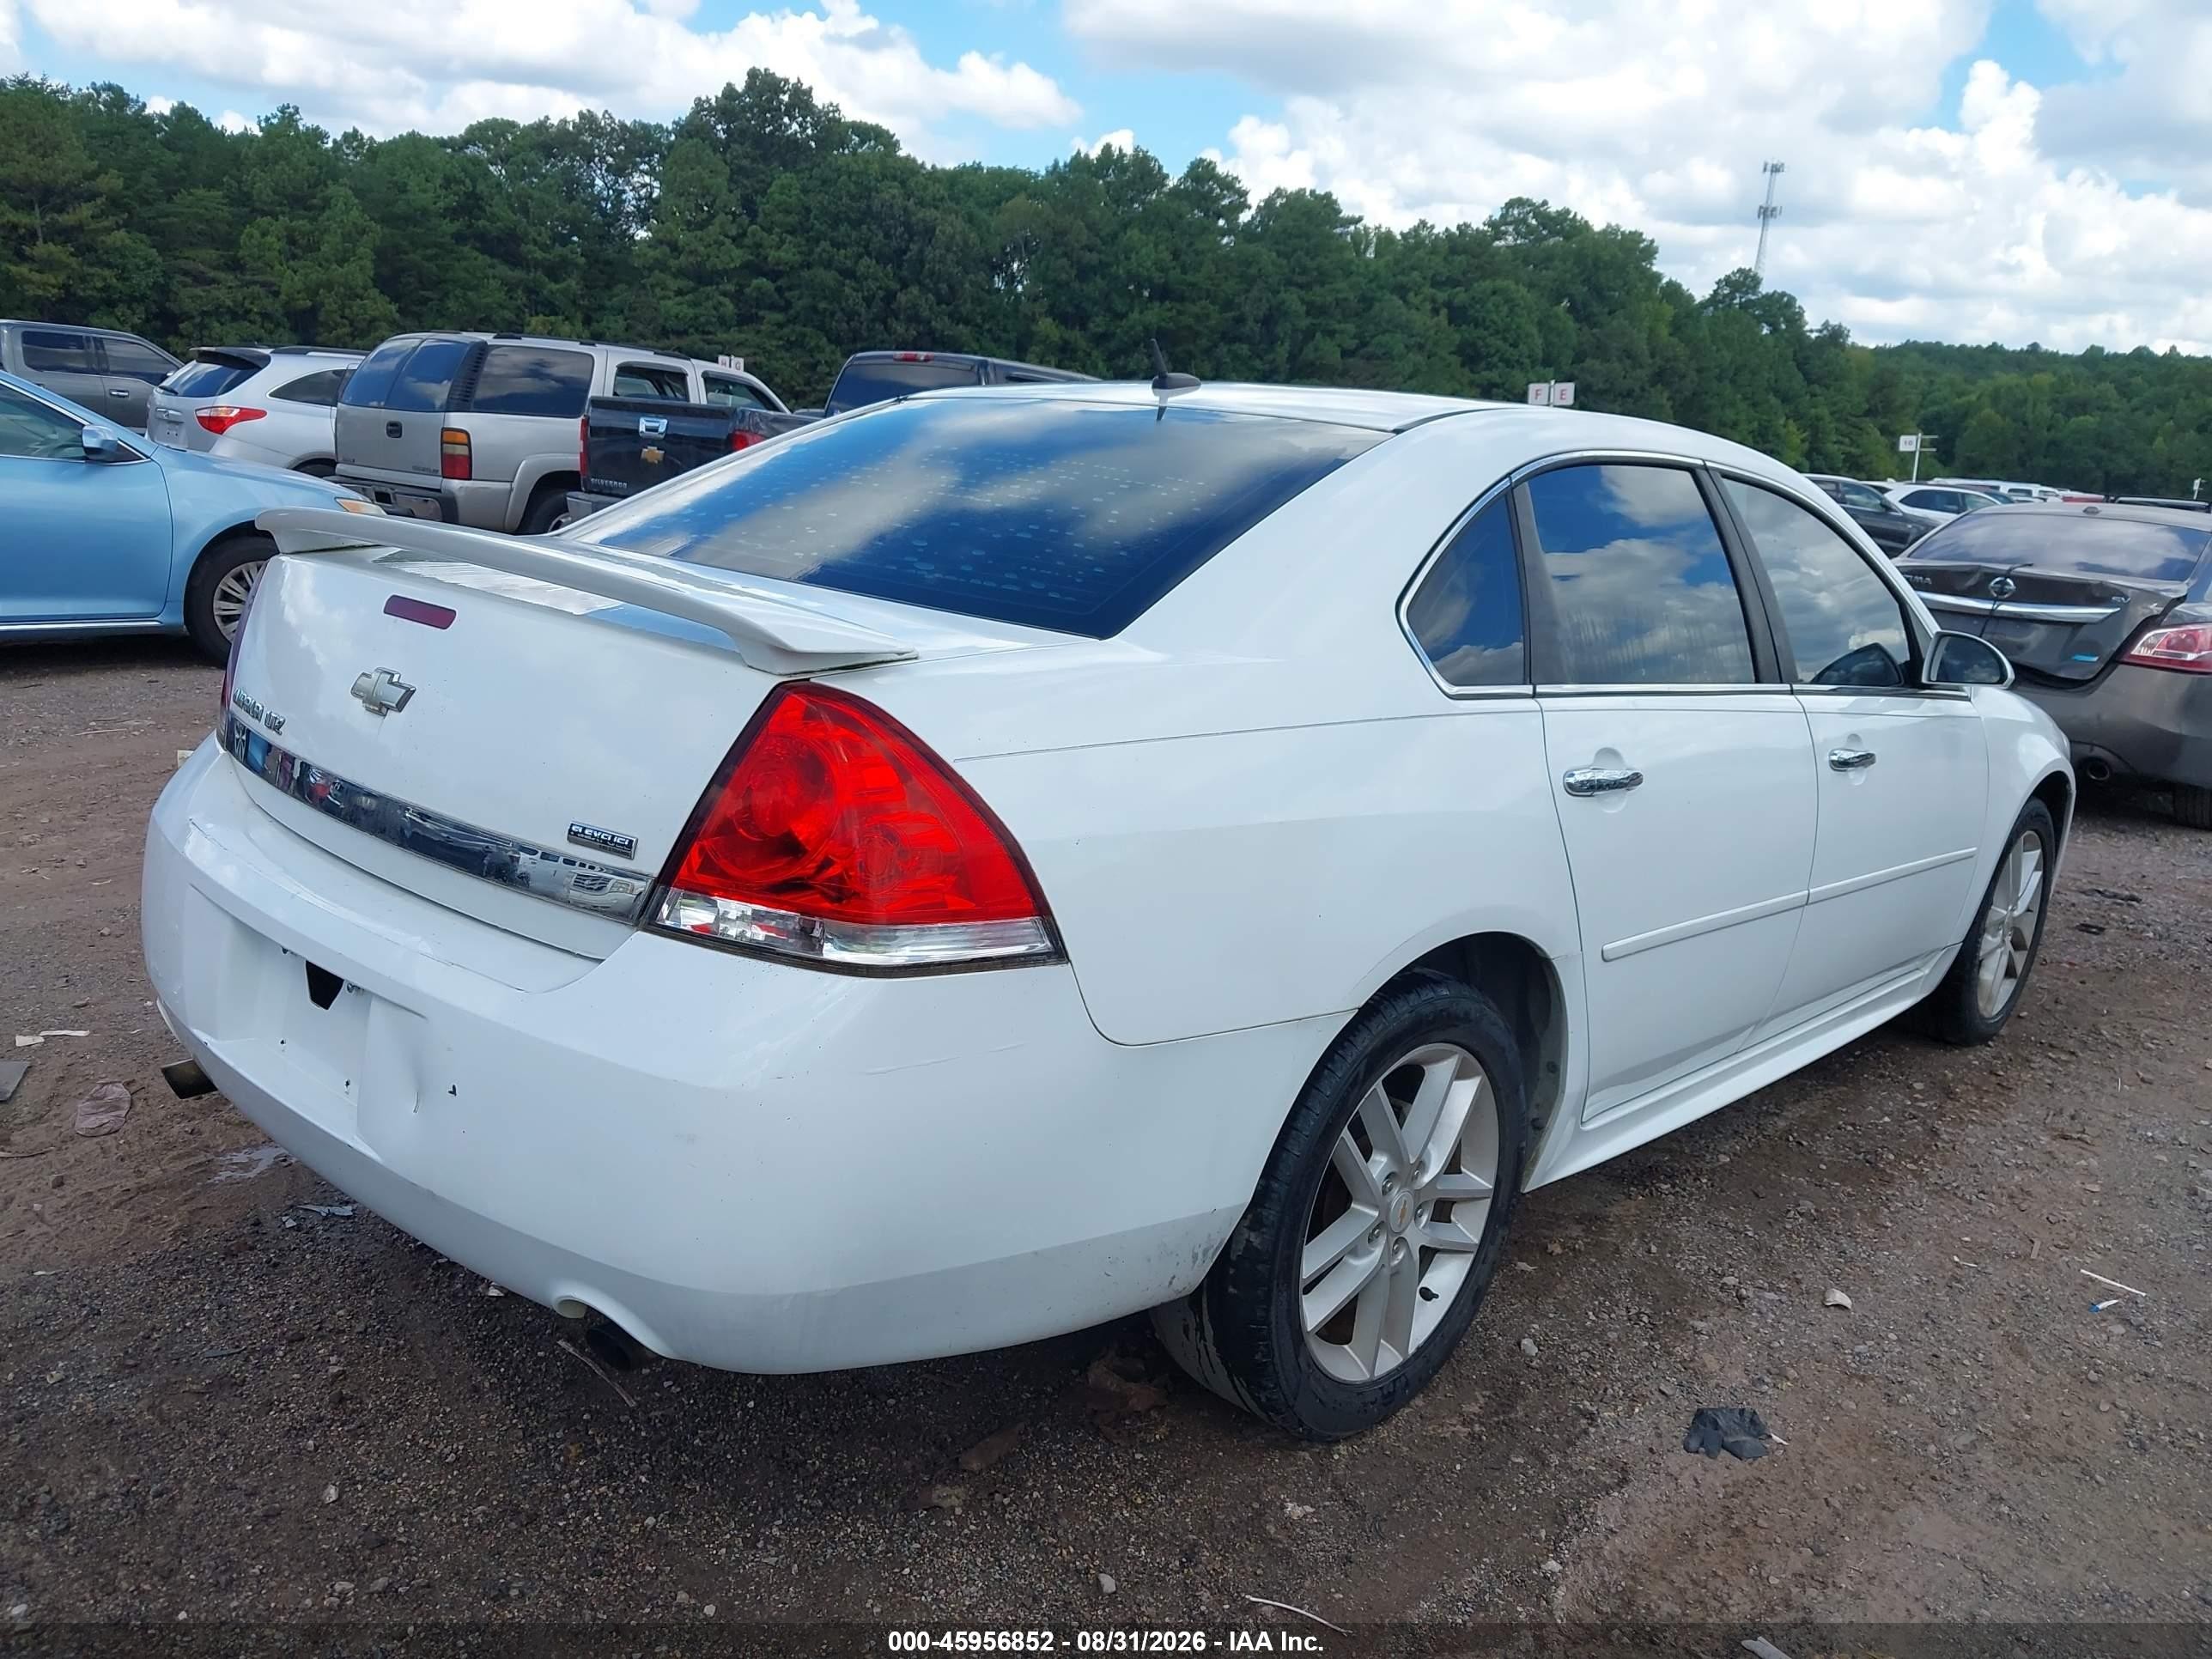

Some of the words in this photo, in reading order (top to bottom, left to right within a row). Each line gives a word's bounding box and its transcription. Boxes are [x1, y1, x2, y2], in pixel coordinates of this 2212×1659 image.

[1534, 388, 1543, 400] F
[1559, 388, 1568, 401] E
[590, 477, 628, 489] SILVERADO
